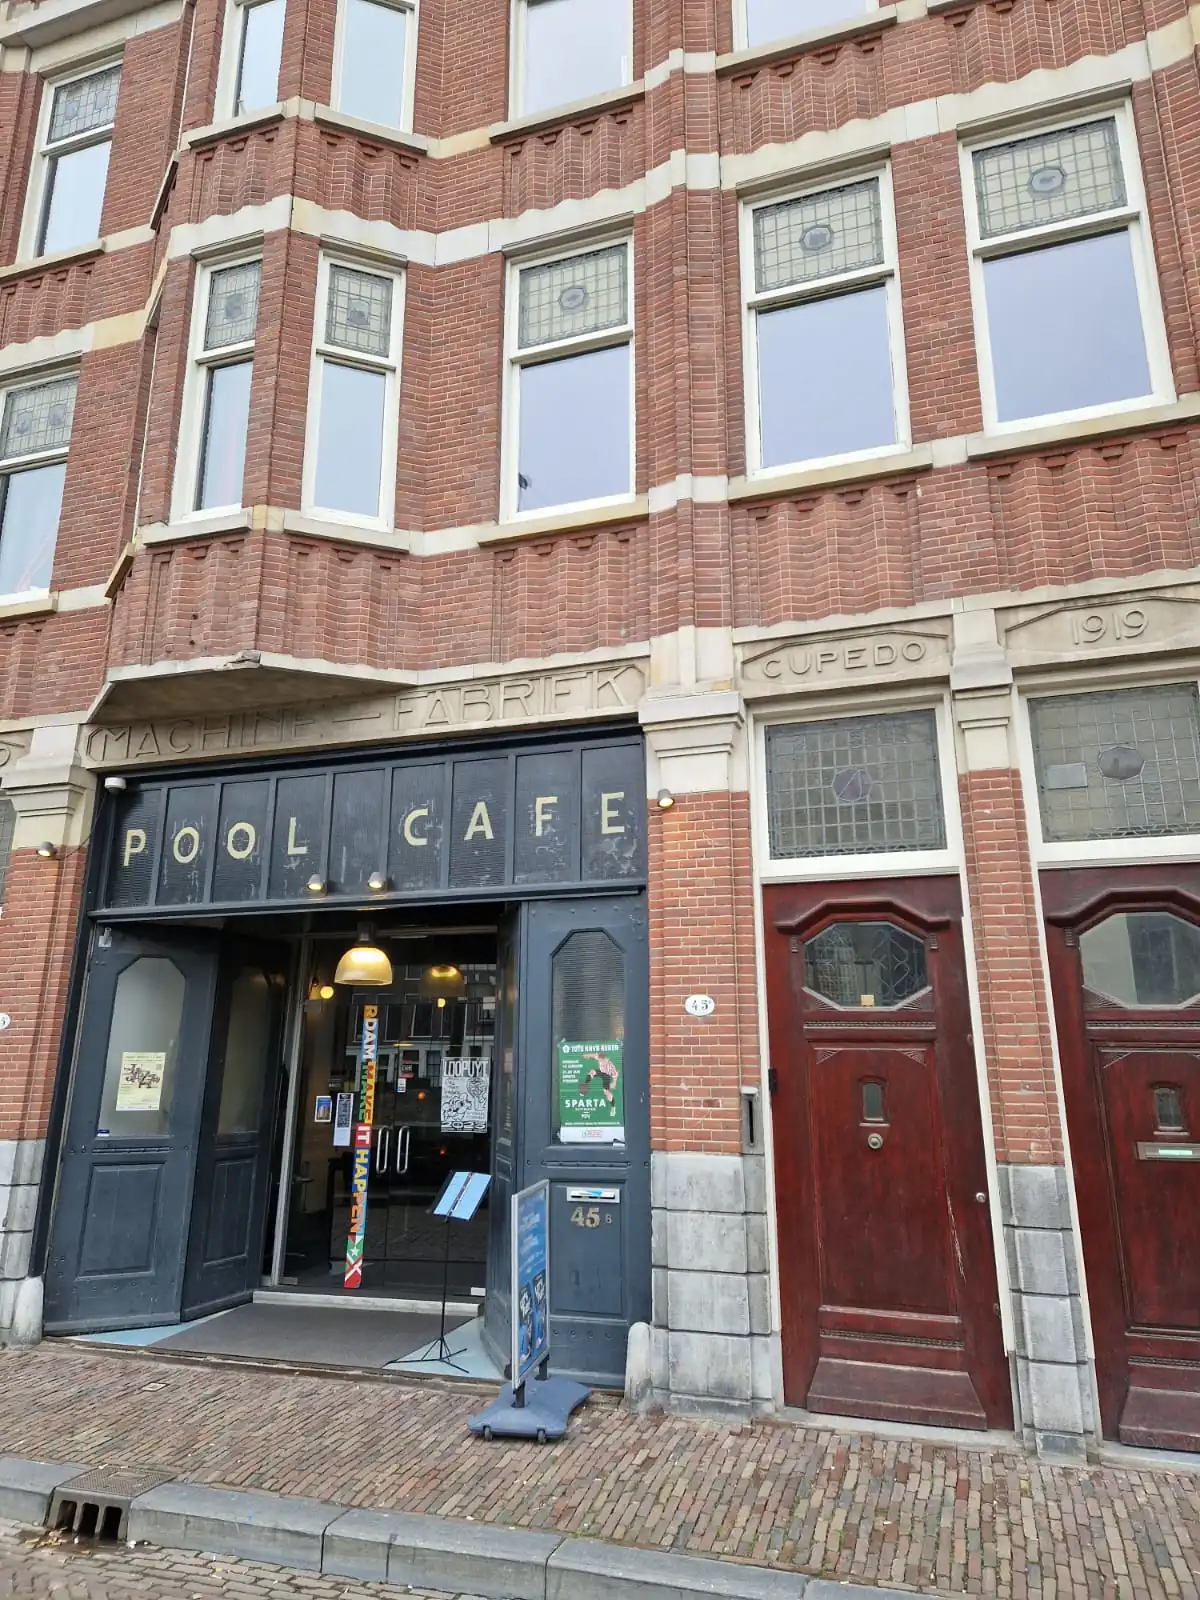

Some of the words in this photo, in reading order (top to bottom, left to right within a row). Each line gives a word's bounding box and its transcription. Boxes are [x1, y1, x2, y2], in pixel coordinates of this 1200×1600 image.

[1070, 608, 1150, 645] 1919
[762, 639, 927, 679] CUPEDO
[101, 706, 316, 762] MACHINE
[393, 664, 635, 731] FABRIEK
[123, 816, 308, 867] POOL
[403, 791, 625, 846] CAFE
[692, 999, 711, 1011] 45
[565, 1099, 606, 1108] SPARTA
[357, 1125, 370, 1145] IT
[350, 1149, 369, 1233] HAPPEN
[571, 1206, 601, 1228] 45
